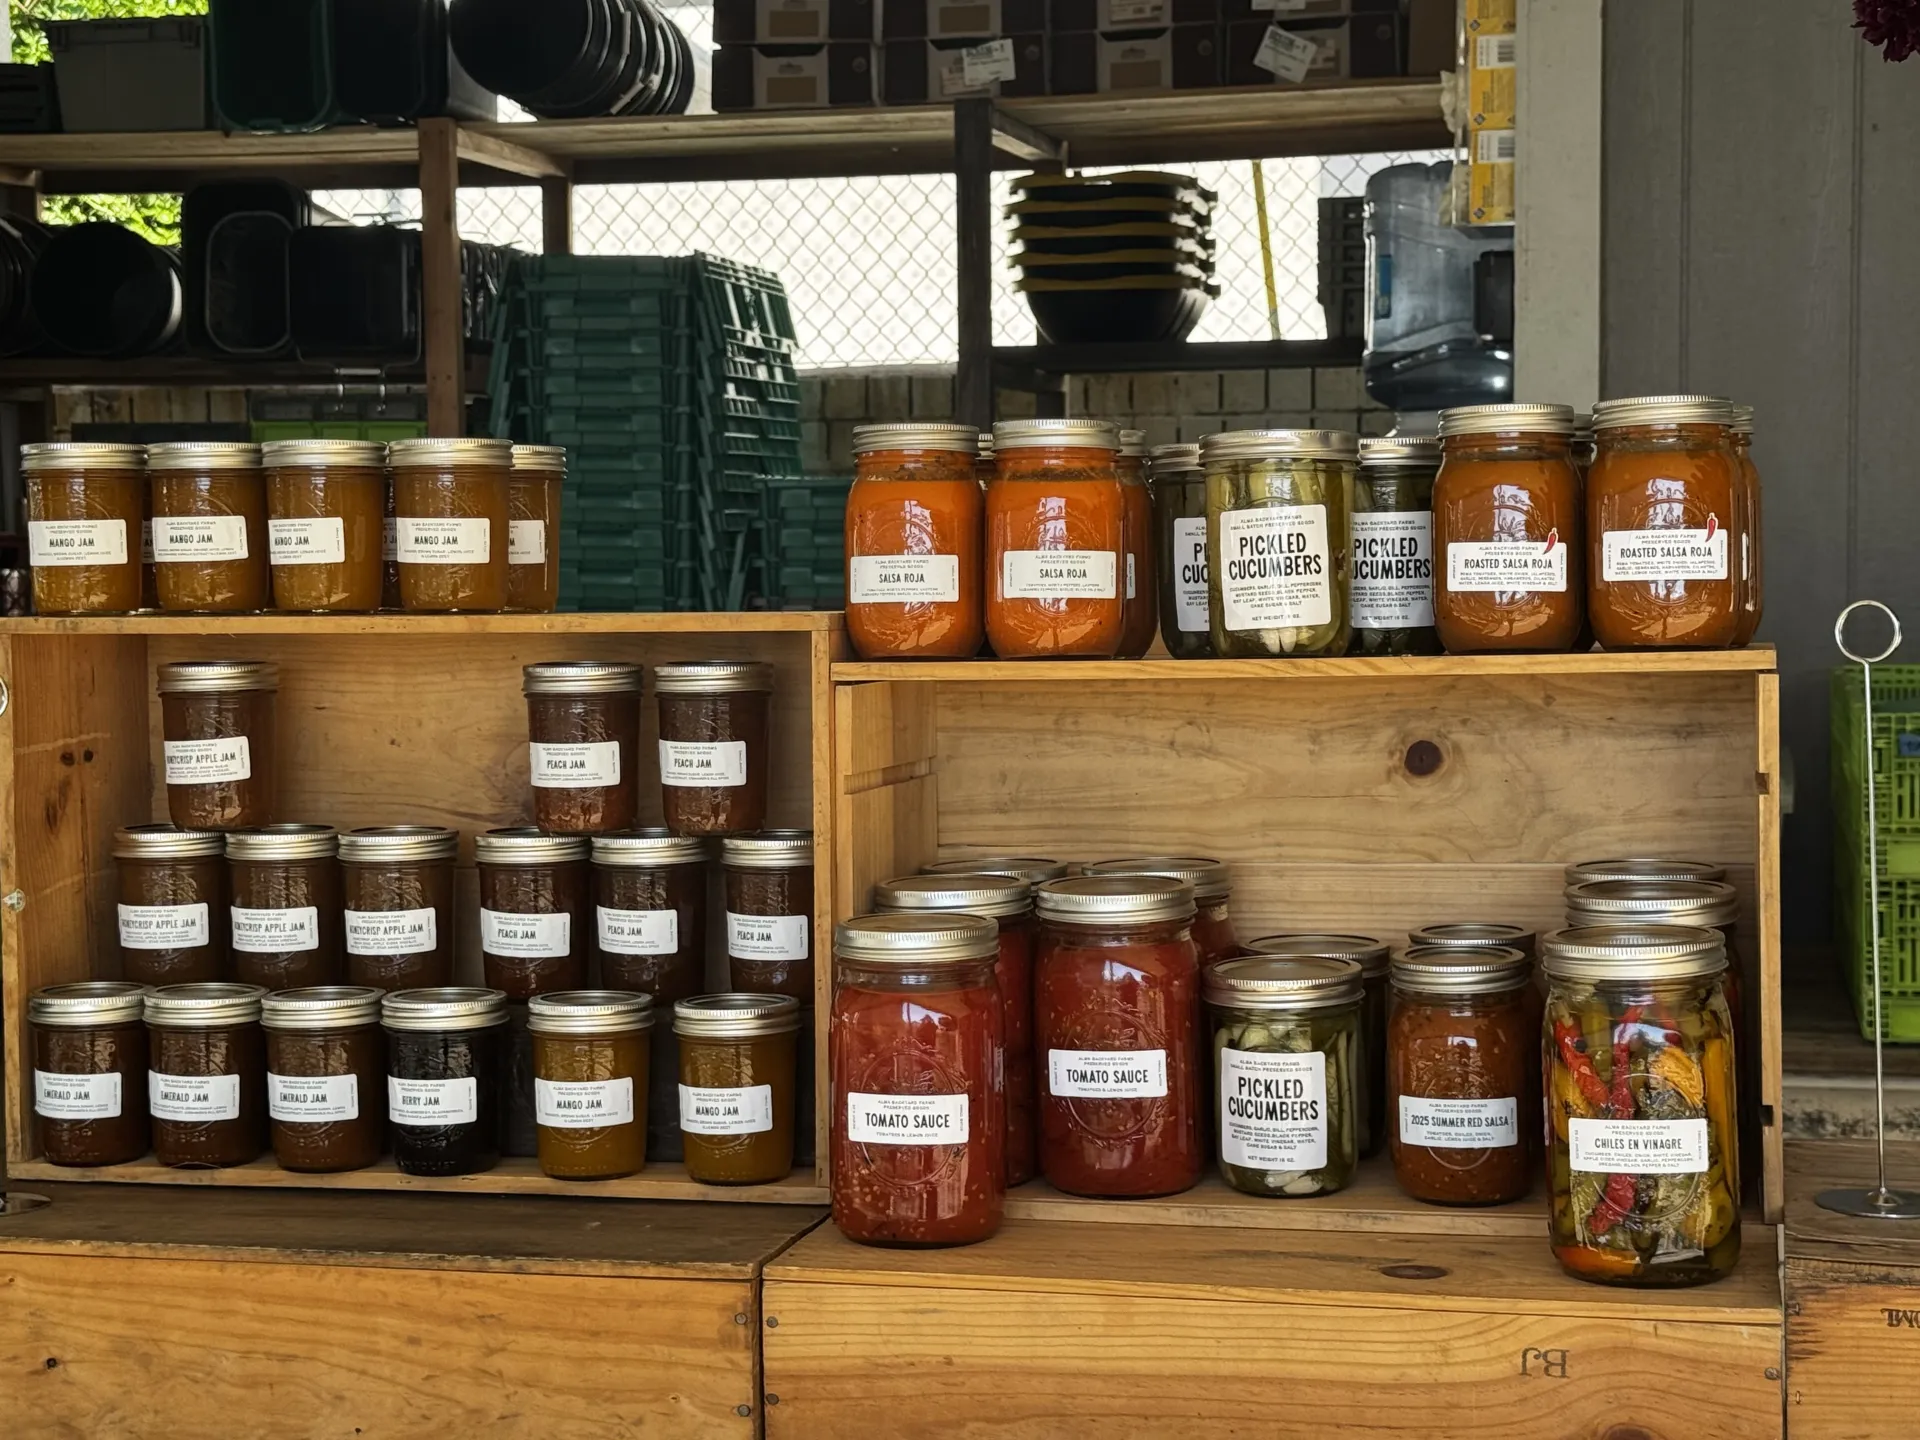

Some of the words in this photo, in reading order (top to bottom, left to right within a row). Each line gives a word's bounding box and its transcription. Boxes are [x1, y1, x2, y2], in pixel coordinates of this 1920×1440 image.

[50, 538, 74, 547] MANGO
[78, 538, 94, 547] JAM
[170, 535, 193, 543] MANGO
[197, 535, 213, 543] JAM
[295, 536, 309, 545] JAM
[414, 536, 438, 545] MANGO
[442, 536, 458, 545] JAM
[1240, 533, 1306, 557] PICKLED
[1353, 537, 1418, 558] PICKLED
[1621, 548, 1657, 558] ROASTED
[1661, 547, 1687, 557] SALSA
[1691, 547, 1712, 557] ROJA
[1229, 554, 1321, 580] CUCUMBERS
[1465, 559, 1499, 568] ROASTED
[1503, 559, 1528, 568] SALSA
[1532, 559, 1552, 568] ROJA
[1040, 569, 1063, 578] SALSA
[1067, 569, 1087, 578] ROJA
[1353, 559, 1430, 580] UCUMBERS
[879, 574, 901, 583] SALSA
[905, 573, 924, 582] ROJA
[196, 754, 218, 763] APPLE
[220, 752, 236, 761] JAM
[674, 758, 693, 768] PEACH
[696, 759, 711, 768] JAM
[547, 760, 566, 769] PEACH
[570, 760, 585, 769] JAM
[156, 920, 178, 929] APPLE
[181, 918, 196, 928] JAM
[265, 923, 286, 932] APPLE
[290, 922, 305, 931] JAM
[383, 925, 405, 935] APPLE
[408, 924, 423, 933] JAM
[498, 929, 517, 938] PEACH
[520, 931, 536, 939] JAM
[608, 925, 624, 935] PEACH
[627, 927, 642, 936] JAM
[737, 930, 754, 941] PEACH
[757, 933, 772, 941] JAM
[1066, 1069, 1108, 1083] TOMATO
[1114, 1070, 1148, 1083] SAUCE
[1238, 1076, 1303, 1099] PICKLED
[44, 1089, 70, 1100] EMERALD
[74, 1092, 90, 1100] JAM
[161, 1091, 189, 1102] EMERALD
[192, 1094, 209, 1102] JAM
[280, 1092, 308, 1103] EMERALD
[311, 1094, 327, 1103] JAM
[402, 1096, 421, 1105] BERRY
[424, 1097, 440, 1106] JAM
[557, 1100, 582, 1109] MANGO
[586, 1100, 602, 1109] JAM
[696, 1106, 719, 1116] MANGO
[723, 1107, 739, 1116] JAM
[1228, 1096, 1318, 1121] CUCUMBERS
[865, 1113, 908, 1128] TOMATO
[914, 1114, 949, 1128] SAUCE
[1411, 1115, 1429, 1125] 2025
[1431, 1117, 1465, 1127] SUMMER
[1467, 1117, 1483, 1127] RED
[1485, 1116, 1509, 1126] SALSA
[1595, 1138, 1624, 1149] CHILES
[1629, 1139, 1639, 1149] EN
[1643, 1139, 1682, 1149] VINAGRE
